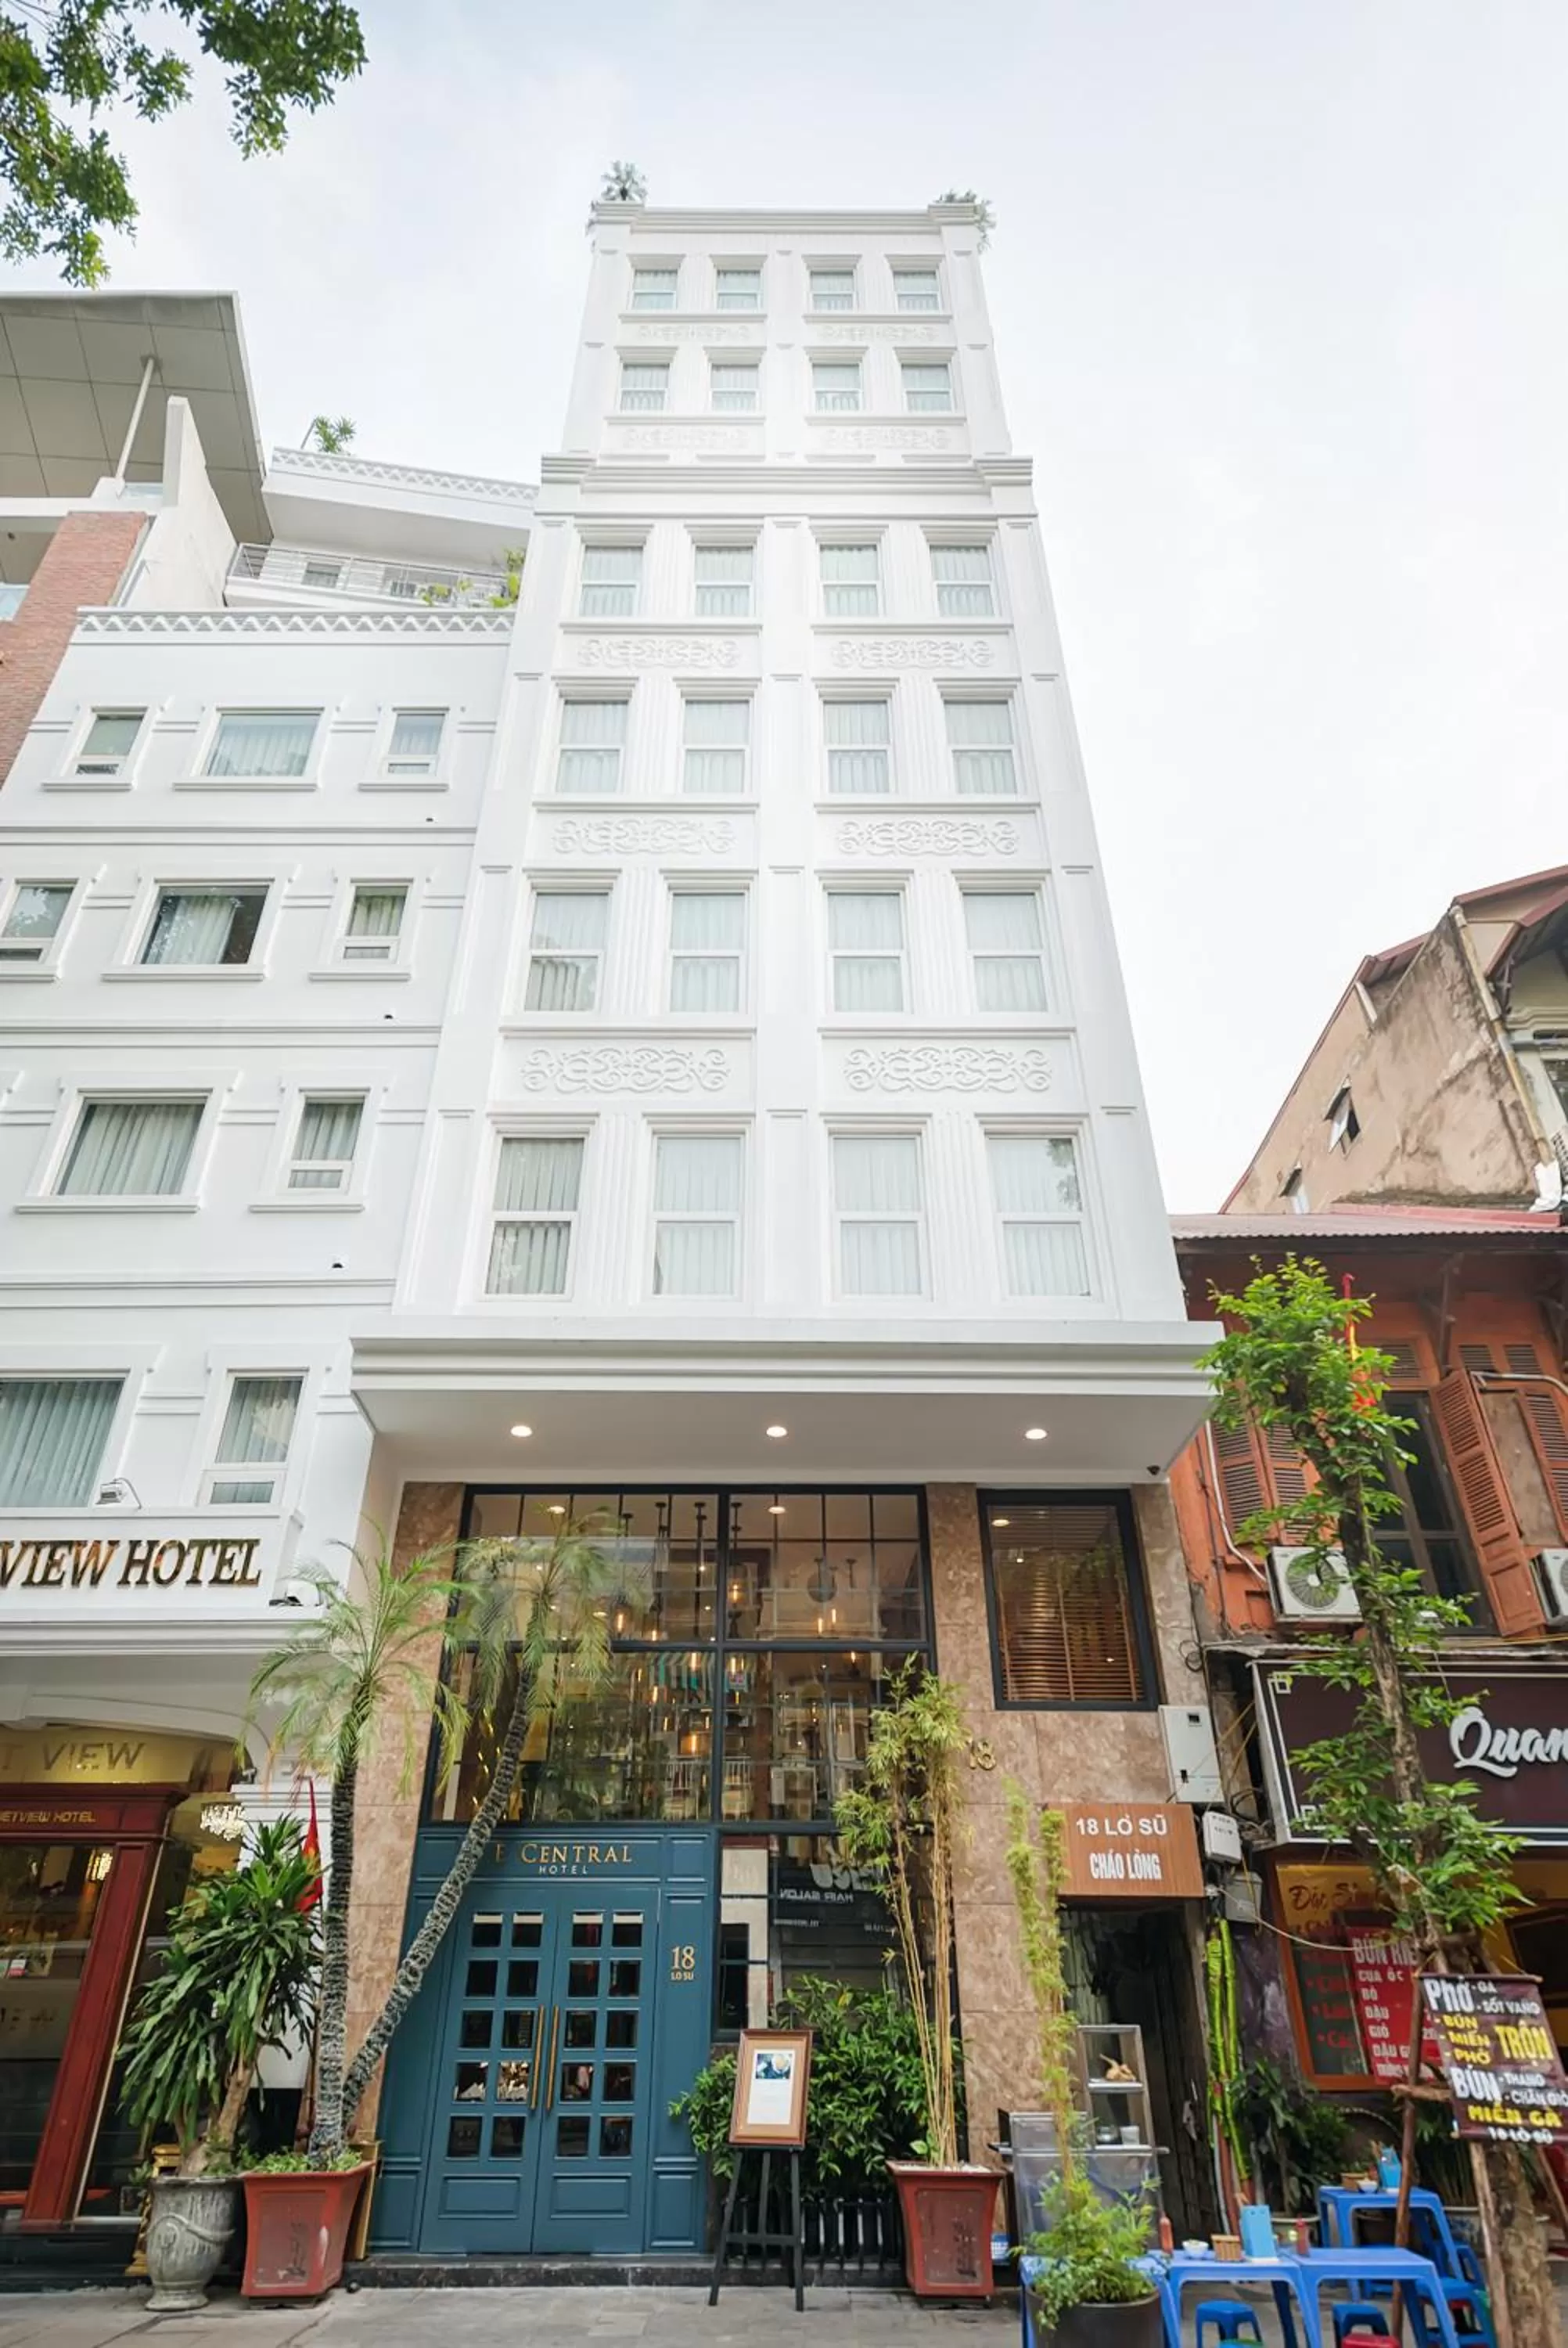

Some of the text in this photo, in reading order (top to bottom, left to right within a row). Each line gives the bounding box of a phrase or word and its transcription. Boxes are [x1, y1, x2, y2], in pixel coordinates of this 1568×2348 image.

[0, 1539, 261, 1587] VIEW HOTEL
[42, 1741, 146, 1771] VIEW
[52, 1810, 97, 1824] HOTEL
[1076, 1817, 1100, 1836] 18
[520, 1842, 634, 1864] CENTRAL
[1089, 1848, 1163, 1881] CHÁO LÒNG
[538, 1865, 589, 1875] HOTEL
[671, 1946, 696, 1970] 18
